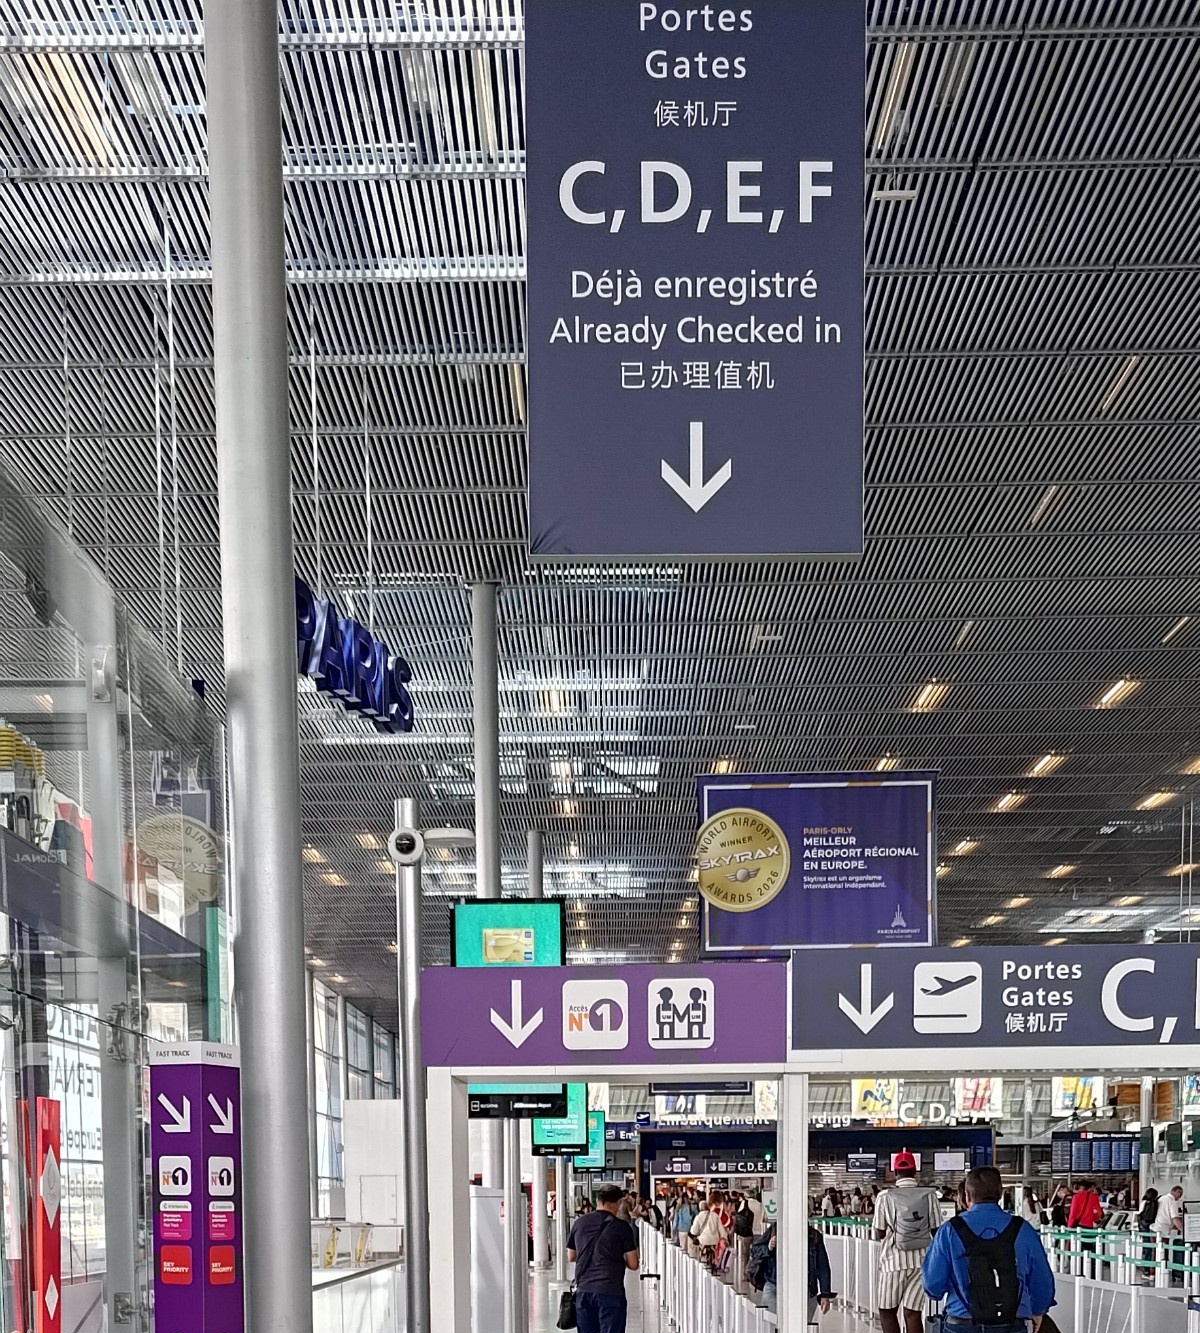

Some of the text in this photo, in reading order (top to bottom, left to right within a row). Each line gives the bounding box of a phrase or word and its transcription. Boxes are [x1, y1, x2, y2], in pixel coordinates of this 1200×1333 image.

[639, 2, 753, 32] Portes
[645, 50, 748, 80] Gates
[654, 100, 738, 127] 候机厅
[559, 161, 834, 233] C,D,E,F
[571, 270, 818, 305] Déjà enregistré
[549, 316, 842, 350] Already Checked in
[620, 361, 775, 390] 已办理值机
[699, 817, 775, 855] WORLD AIRPORT
[719, 835, 753, 848] WINNER
[803, 827, 853, 835] PARIS-ORLY
[803, 836, 857, 846] MEILLEUR
[699, 845, 779, 870] SKYTRAX
[803, 846, 919, 858] AÉROPORT RÉGIONAL
[803, 860, 868, 870] EN EUROPE.
[706, 870, 779, 903] AWARDS 2026
[1002, 960, 1082, 981] Portes
[569, 1004, 588, 1012] Accès
[1002, 987, 1074, 1007] Gates
[1005, 1012, 1068, 1033] 候机厅
[206, 1050, 233, 1060] FAST TRACK
